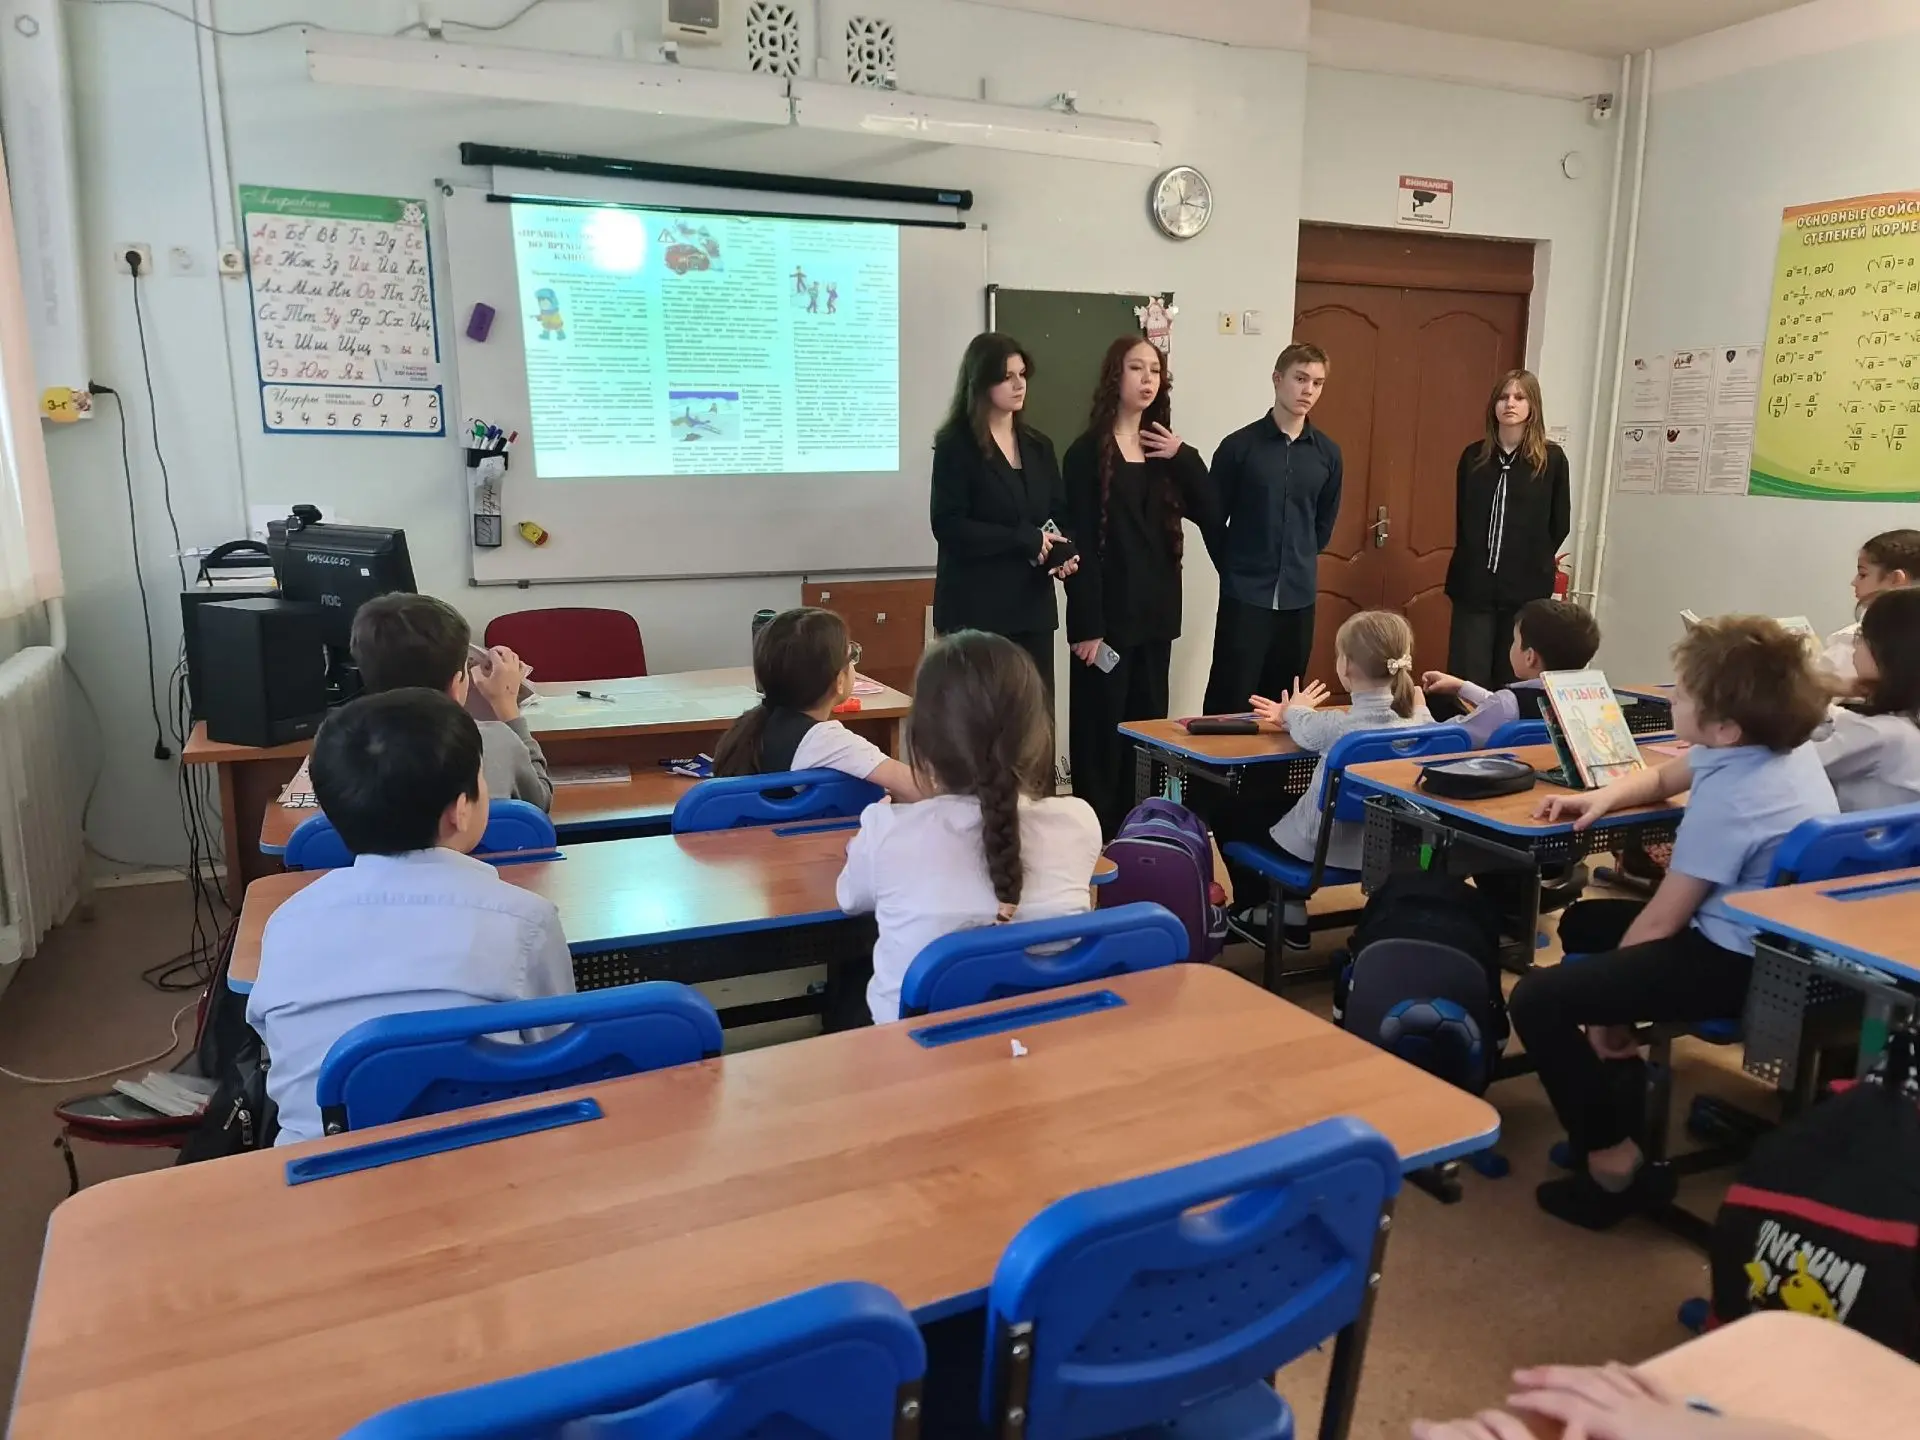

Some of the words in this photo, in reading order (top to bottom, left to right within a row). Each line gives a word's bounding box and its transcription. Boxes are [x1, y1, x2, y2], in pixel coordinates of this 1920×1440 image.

[1796, 208, 1867, 229] ОСНОВНЫЕ
[1803, 225, 1866, 246] СТЕПЕНЕЙ
[372, 393, 383, 407] 0
[402, 394, 410, 407] 1
[428, 394, 437, 408] 2
[274, 411, 284, 425] 3
[301, 412, 310, 425] 4
[327, 413, 337, 426] 5
[352, 414, 362, 427] 6
[379, 414, 388, 427] 7
[403, 415, 413, 428] 8
[429, 416, 438, 428] 9
[1557, 686, 1609, 702] МУЗЫКА
